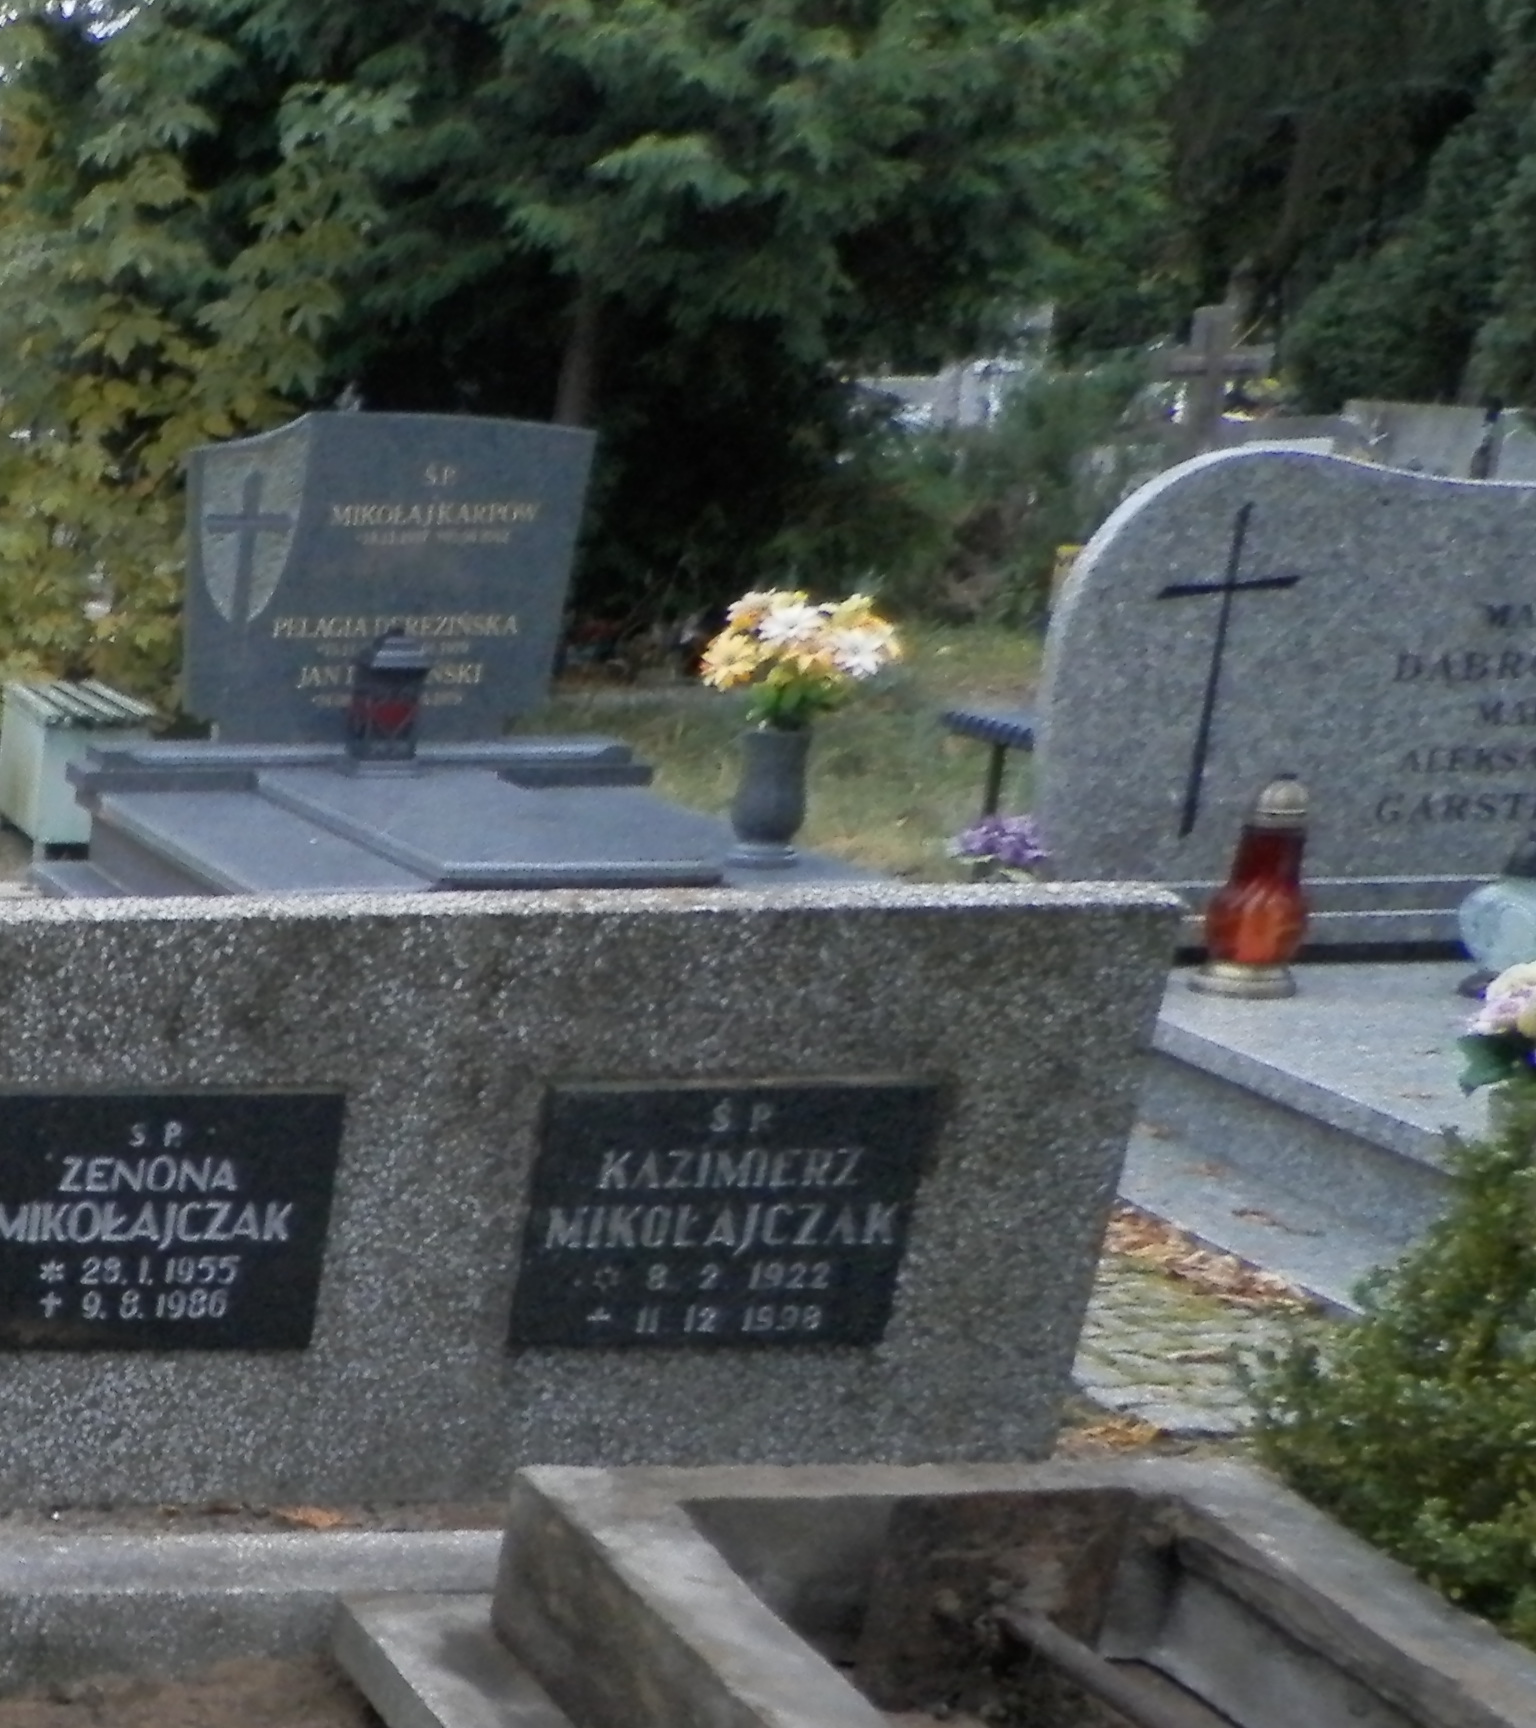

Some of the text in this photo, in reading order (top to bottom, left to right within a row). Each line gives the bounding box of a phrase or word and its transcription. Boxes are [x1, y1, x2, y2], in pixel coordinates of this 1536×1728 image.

[57, 1153, 239, 1193] ZENONA
[595, 1147, 866, 1190] KAZIMIERZ
[544, 1200, 900, 1257] MIKOŁAJCZAK
[164, 1254, 242, 1285] 1955
[155, 1287, 229, 1320] 1986
